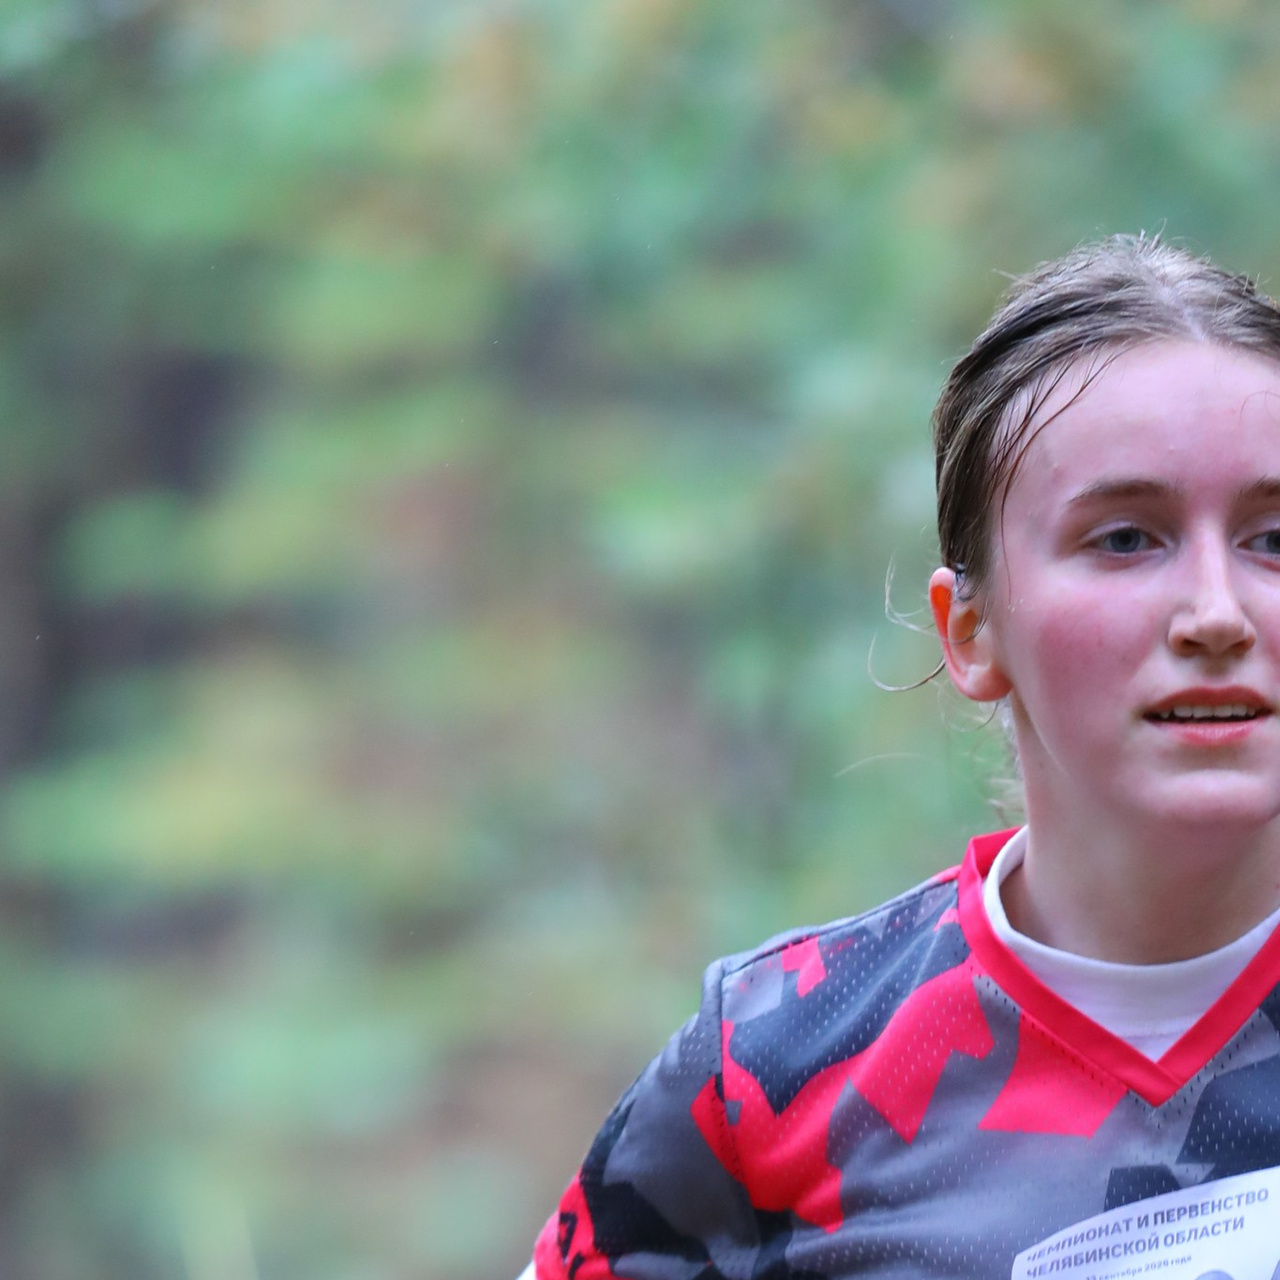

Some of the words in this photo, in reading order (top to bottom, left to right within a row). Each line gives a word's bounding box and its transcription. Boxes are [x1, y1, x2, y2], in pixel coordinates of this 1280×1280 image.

[1027, 1217, 1133, 1262] ЧЕМПИОНАТ
[1137, 1213, 1149, 1229] И
[1153, 1188, 1269, 1226] ПЕРВЕНСТВО
[1027, 1231, 1160, 1279] ЧЕЛЯБИНСКОЙ
[1163, 1215, 1245, 1248] ОБЛАСТИ
